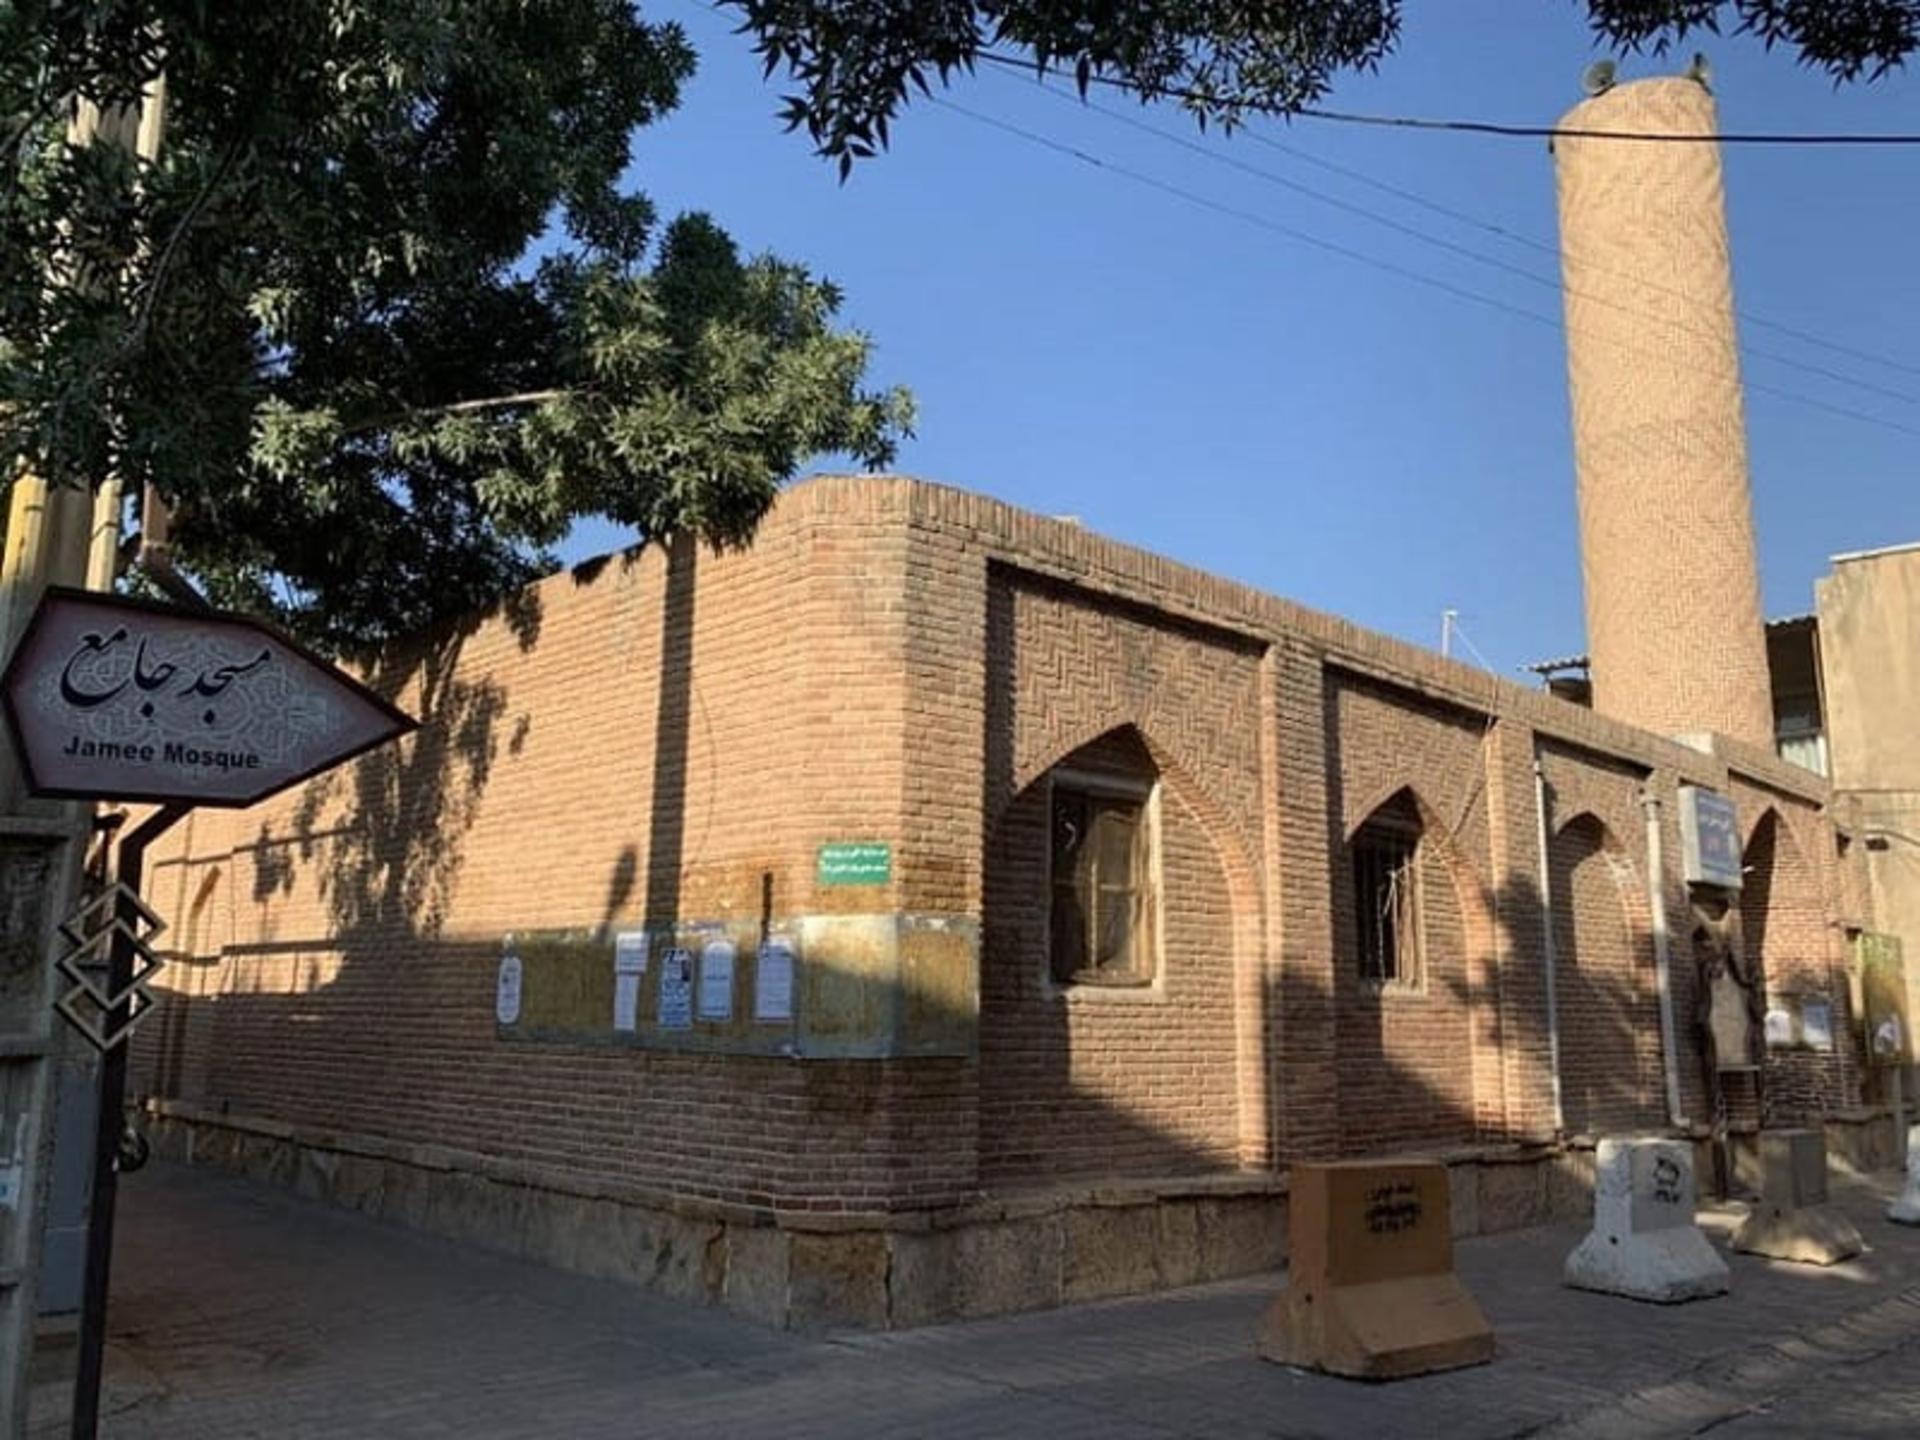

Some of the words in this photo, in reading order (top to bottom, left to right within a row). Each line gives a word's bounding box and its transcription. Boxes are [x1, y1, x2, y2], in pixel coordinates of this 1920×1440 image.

[61, 627, 177, 717] جامع
[178, 649, 271, 723] مسجد
[64, 736, 156, 762] Jamee
[164, 743, 260, 772] Mosque
